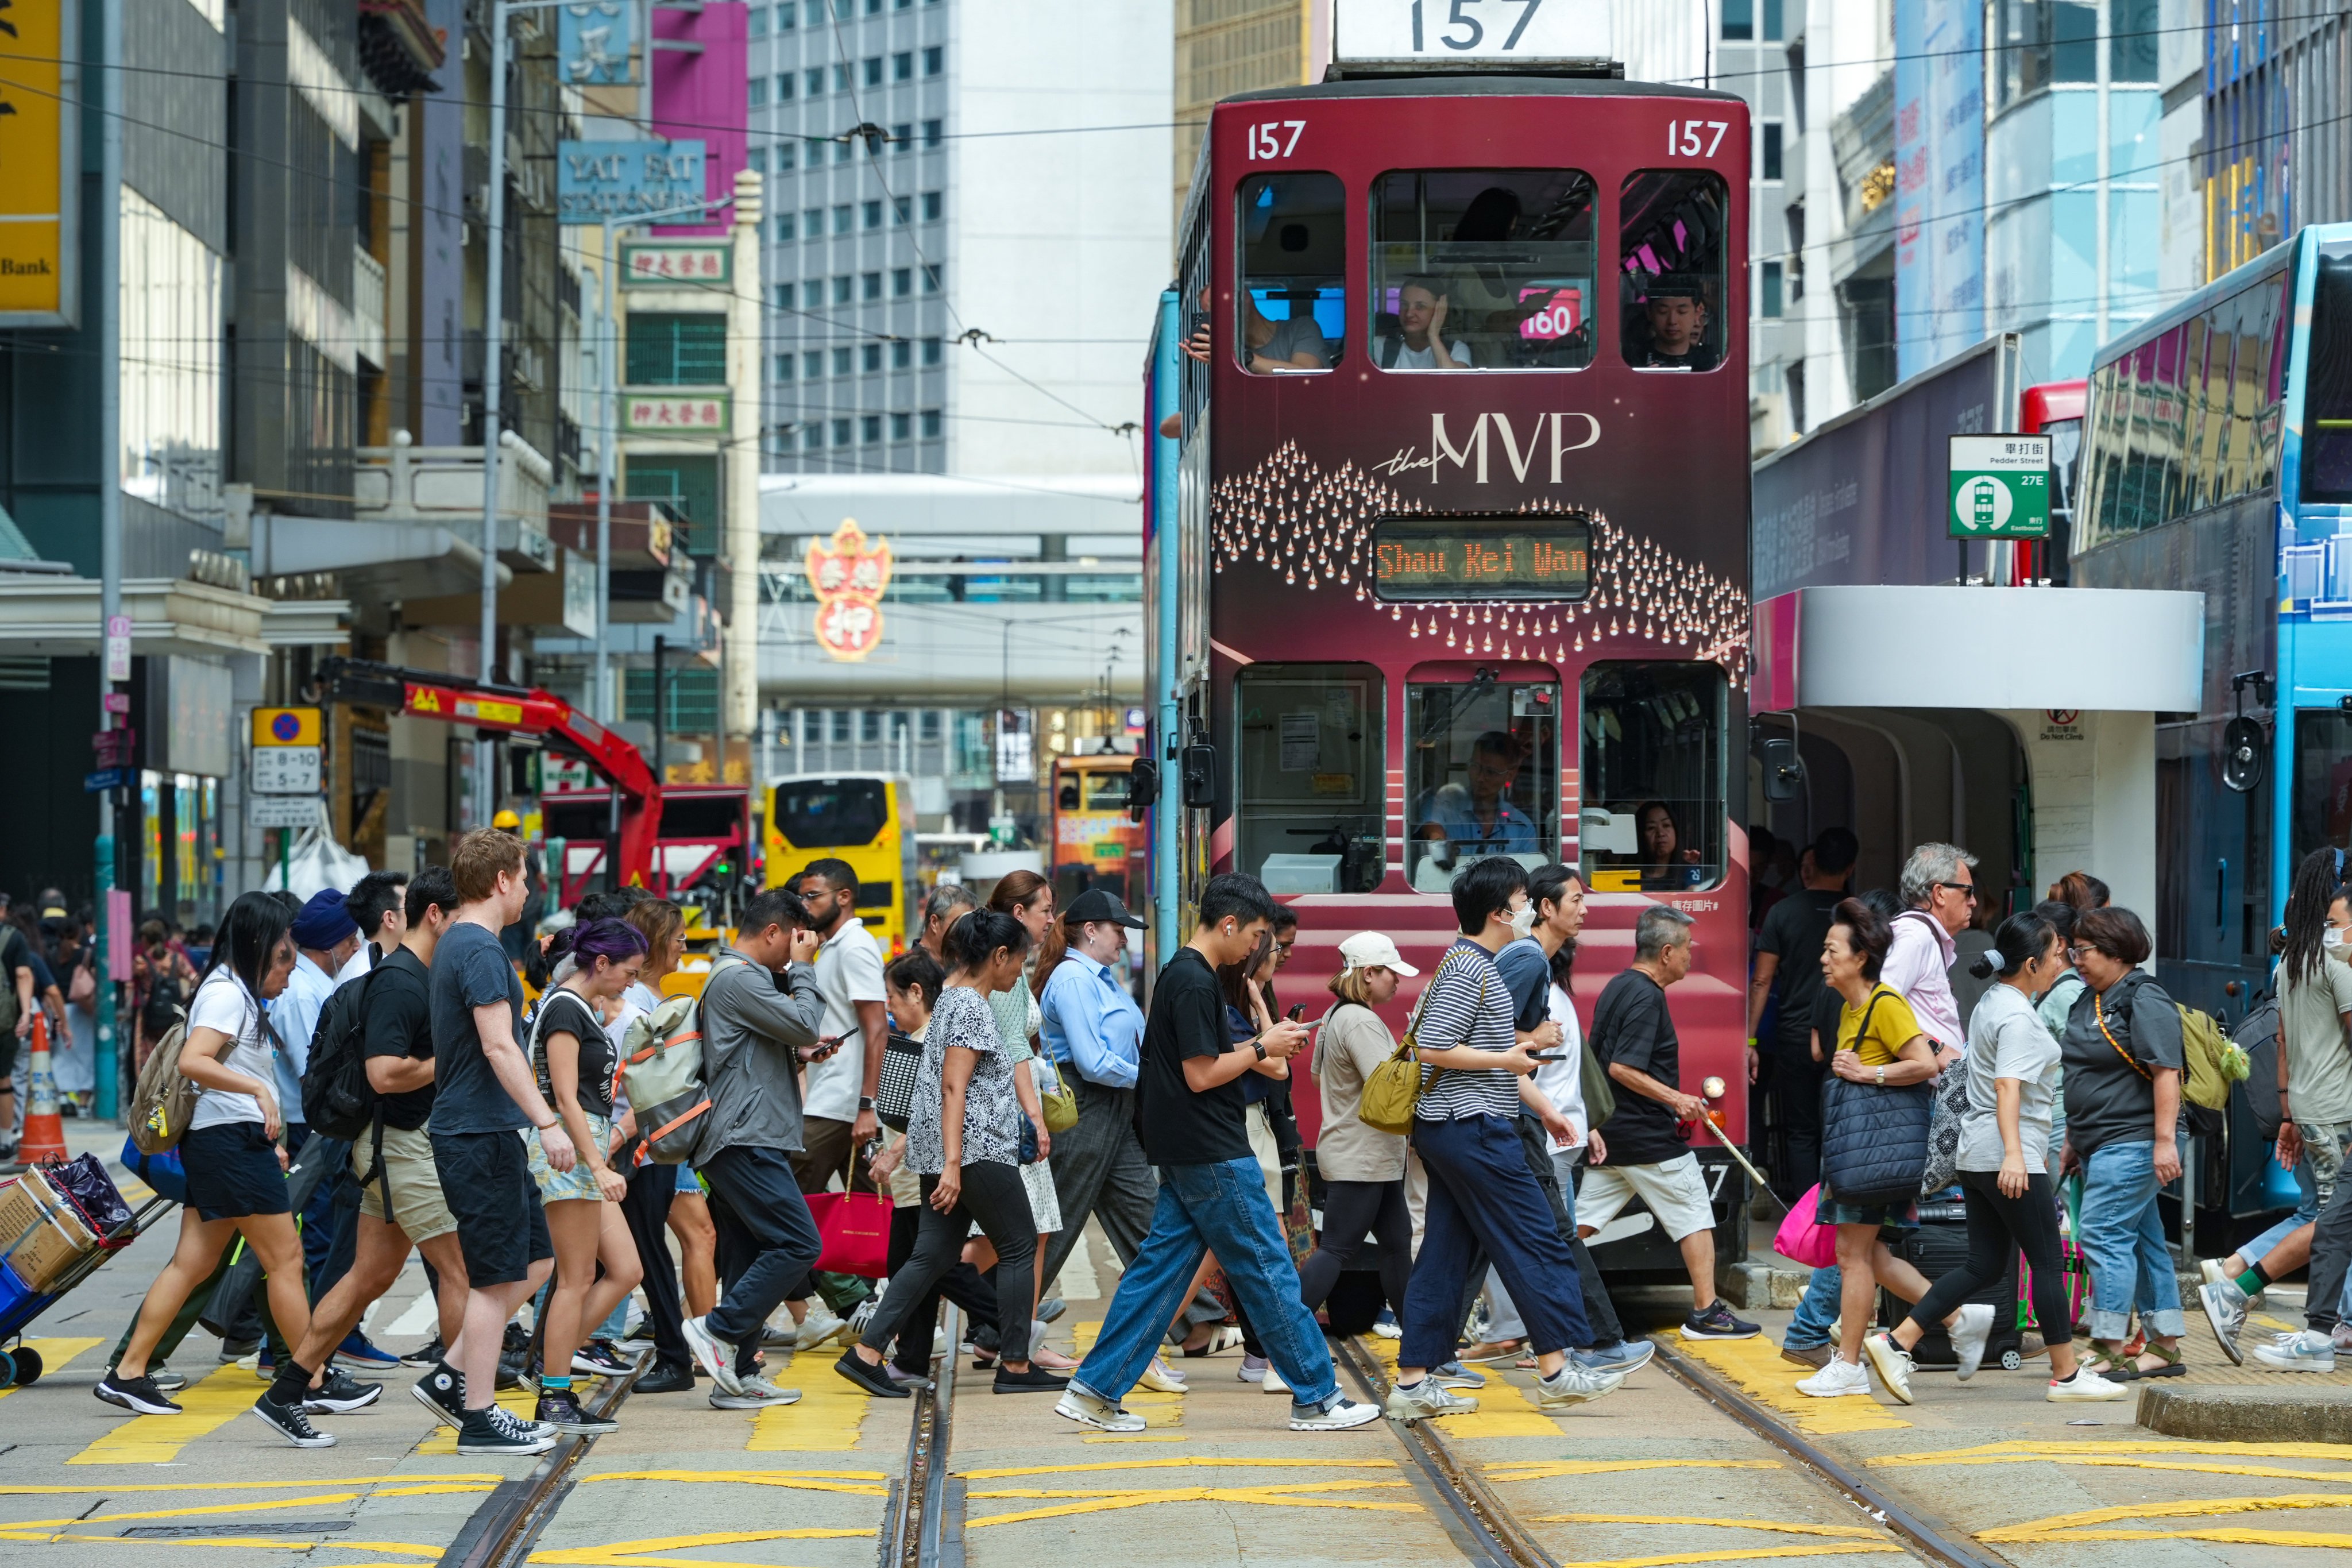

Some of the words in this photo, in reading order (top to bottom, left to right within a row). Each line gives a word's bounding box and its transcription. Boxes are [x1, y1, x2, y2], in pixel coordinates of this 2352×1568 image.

[1410, 0, 1542, 51] 157
[1248, 120, 1307, 160] 157
[1668, 119, 1729, 158] 157
[565, 154, 627, 182] YAT
[560, 192, 704, 212] STATIONERS
[1, 259, 51, 276] Bank
[1528, 305, 1571, 336] 160
[1372, 446, 1446, 476] the
[1431, 412, 1601, 484] MVP
[2005, 443, 2044, 455] 畢打街
[2021, 476, 2044, 485] 27E
[1377, 544, 1446, 578] Shau
[1464, 543, 1513, 577] Kei
[1534, 543, 1586, 576] Wan
[9, 1202, 21, 1218] Product
[12, 1199, 25, 1214] Product
[16, 1195, 26, 1208] Order
[0, 1215, 9, 1228] arton
[5, 1207, 17, 1220] Carton
[28, 1262, 37, 1273] KGS
